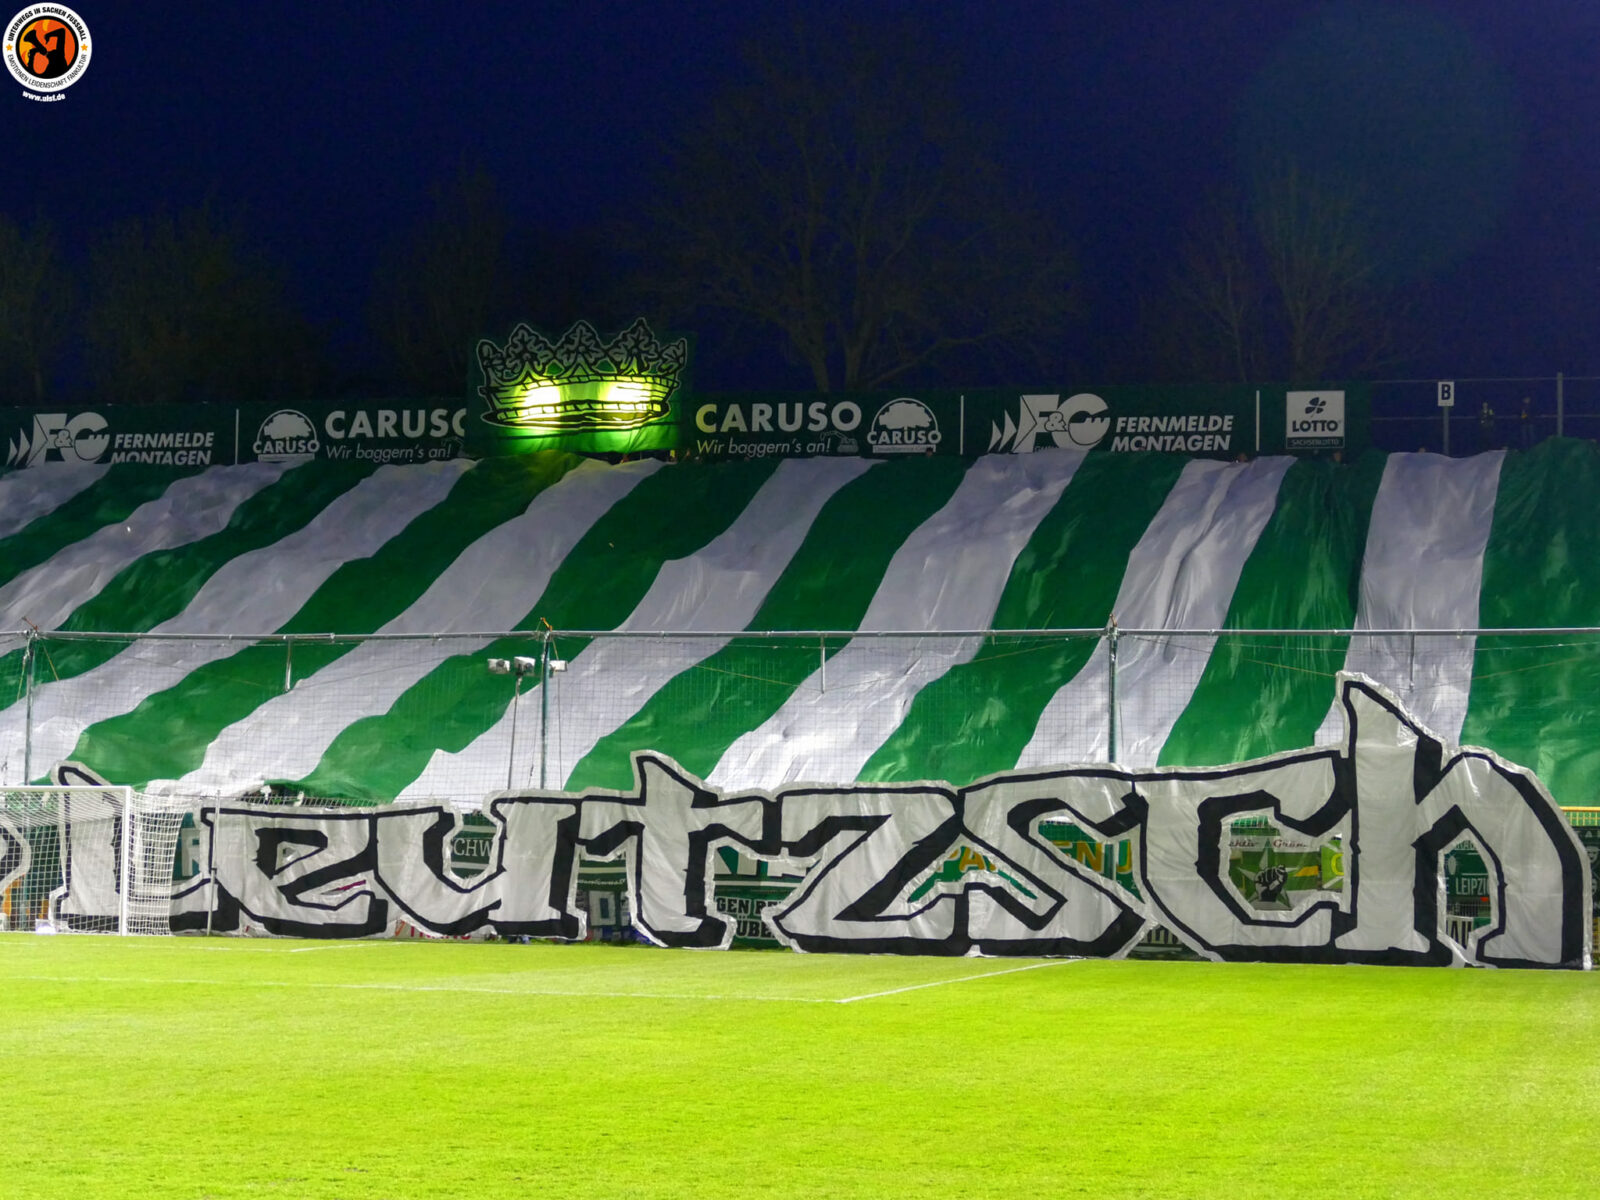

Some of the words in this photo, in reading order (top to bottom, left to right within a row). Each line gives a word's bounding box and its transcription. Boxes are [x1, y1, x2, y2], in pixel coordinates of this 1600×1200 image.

[1440, 383, 1452, 400] B
[695, 401, 862, 434] CARUSO
[1115, 415, 1235, 433] FERNMELDE
[1292, 419, 1338, 433] LOTTO
[114, 431, 215, 449] FERNMELDE
[696, 438, 724, 455] Wir
[806, 437, 831, 454] an!
[866, 430, 942, 446] CARUSO
[1110, 434, 1232, 452] MONTAGEN
[252, 439, 321, 455] CARUSO
[325, 445, 352, 459] Wir
[428, 443, 452, 459] an!
[110, 449, 212, 466] MONTAGEN
